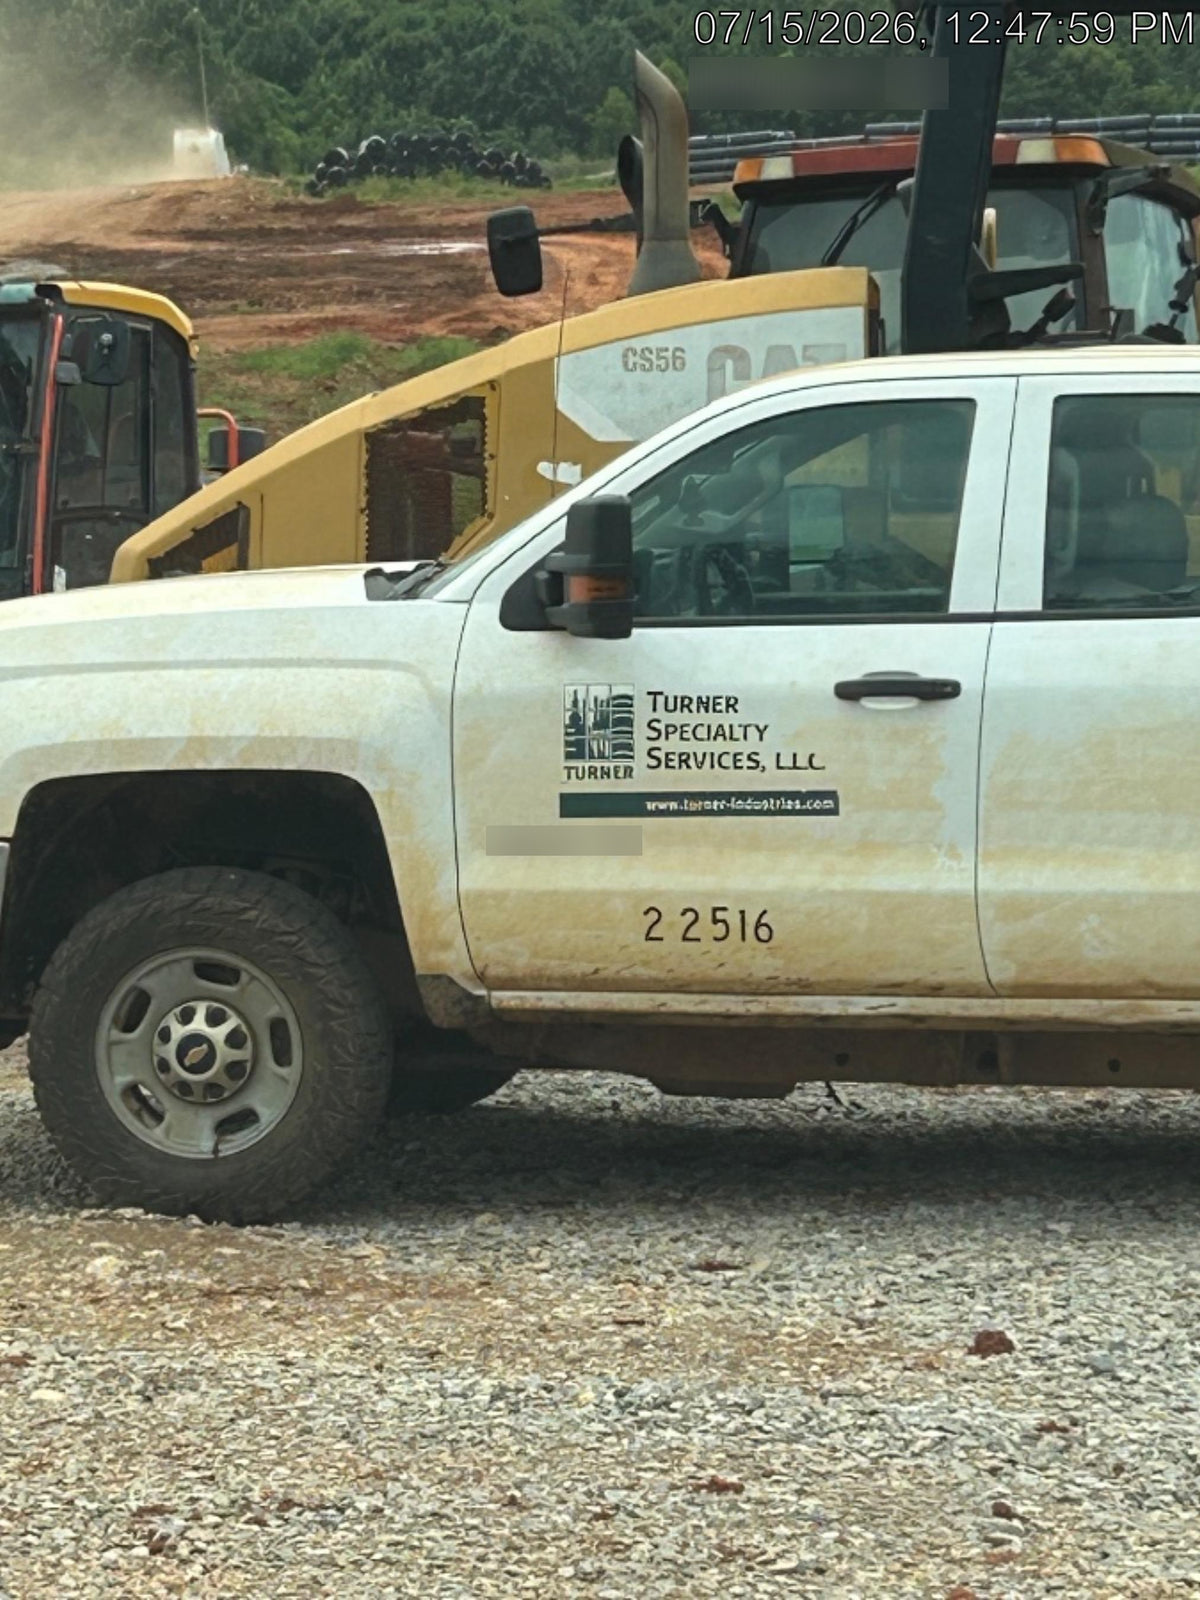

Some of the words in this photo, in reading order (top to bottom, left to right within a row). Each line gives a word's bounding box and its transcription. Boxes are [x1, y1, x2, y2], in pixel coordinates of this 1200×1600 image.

[621, 346, 686, 373] CS56
[646, 690, 739, 714] TURNER
[646, 718, 768, 742] SPECIALTY
[646, 746, 766, 773] SERVICES,
[563, 765, 634, 781] TURNER
